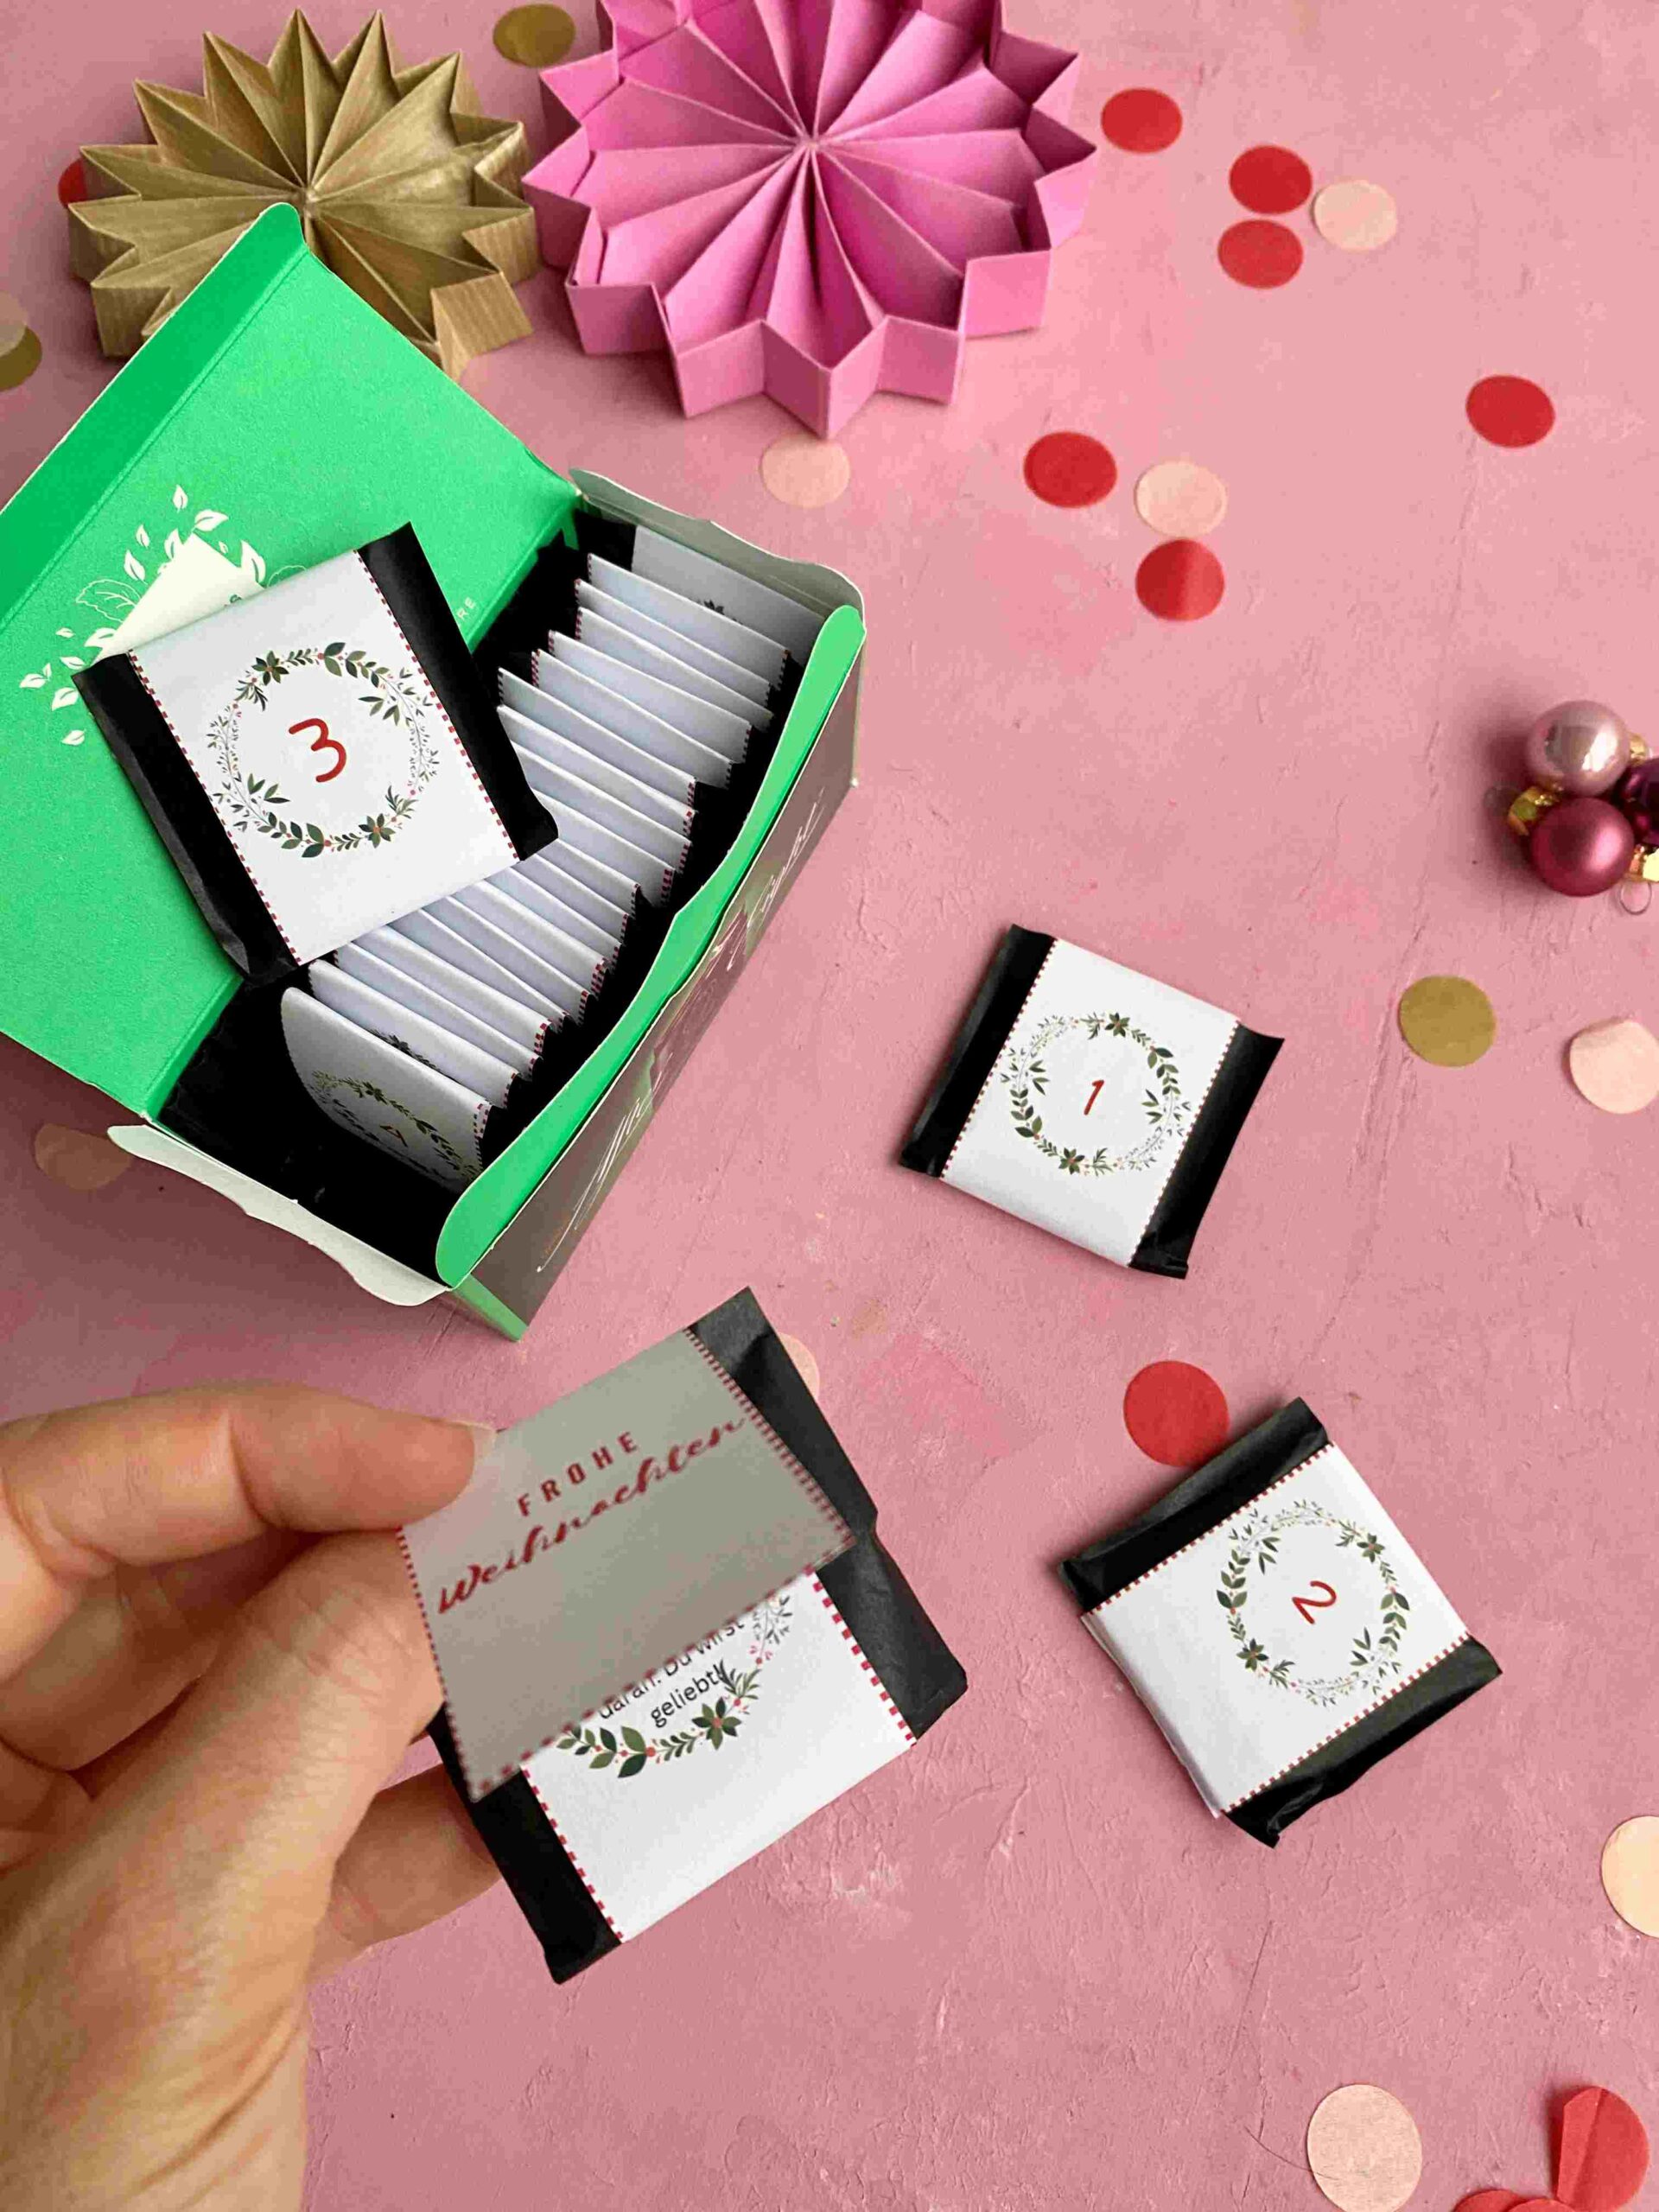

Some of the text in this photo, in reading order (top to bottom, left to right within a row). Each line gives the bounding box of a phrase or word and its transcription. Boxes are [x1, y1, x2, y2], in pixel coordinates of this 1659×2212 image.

[289, 718, 346, 782] 3
[1084, 1079, 1104, 1116] 1
[517, 1431, 639, 1517] FROHE
[1291, 1580, 1338, 1625] 2
